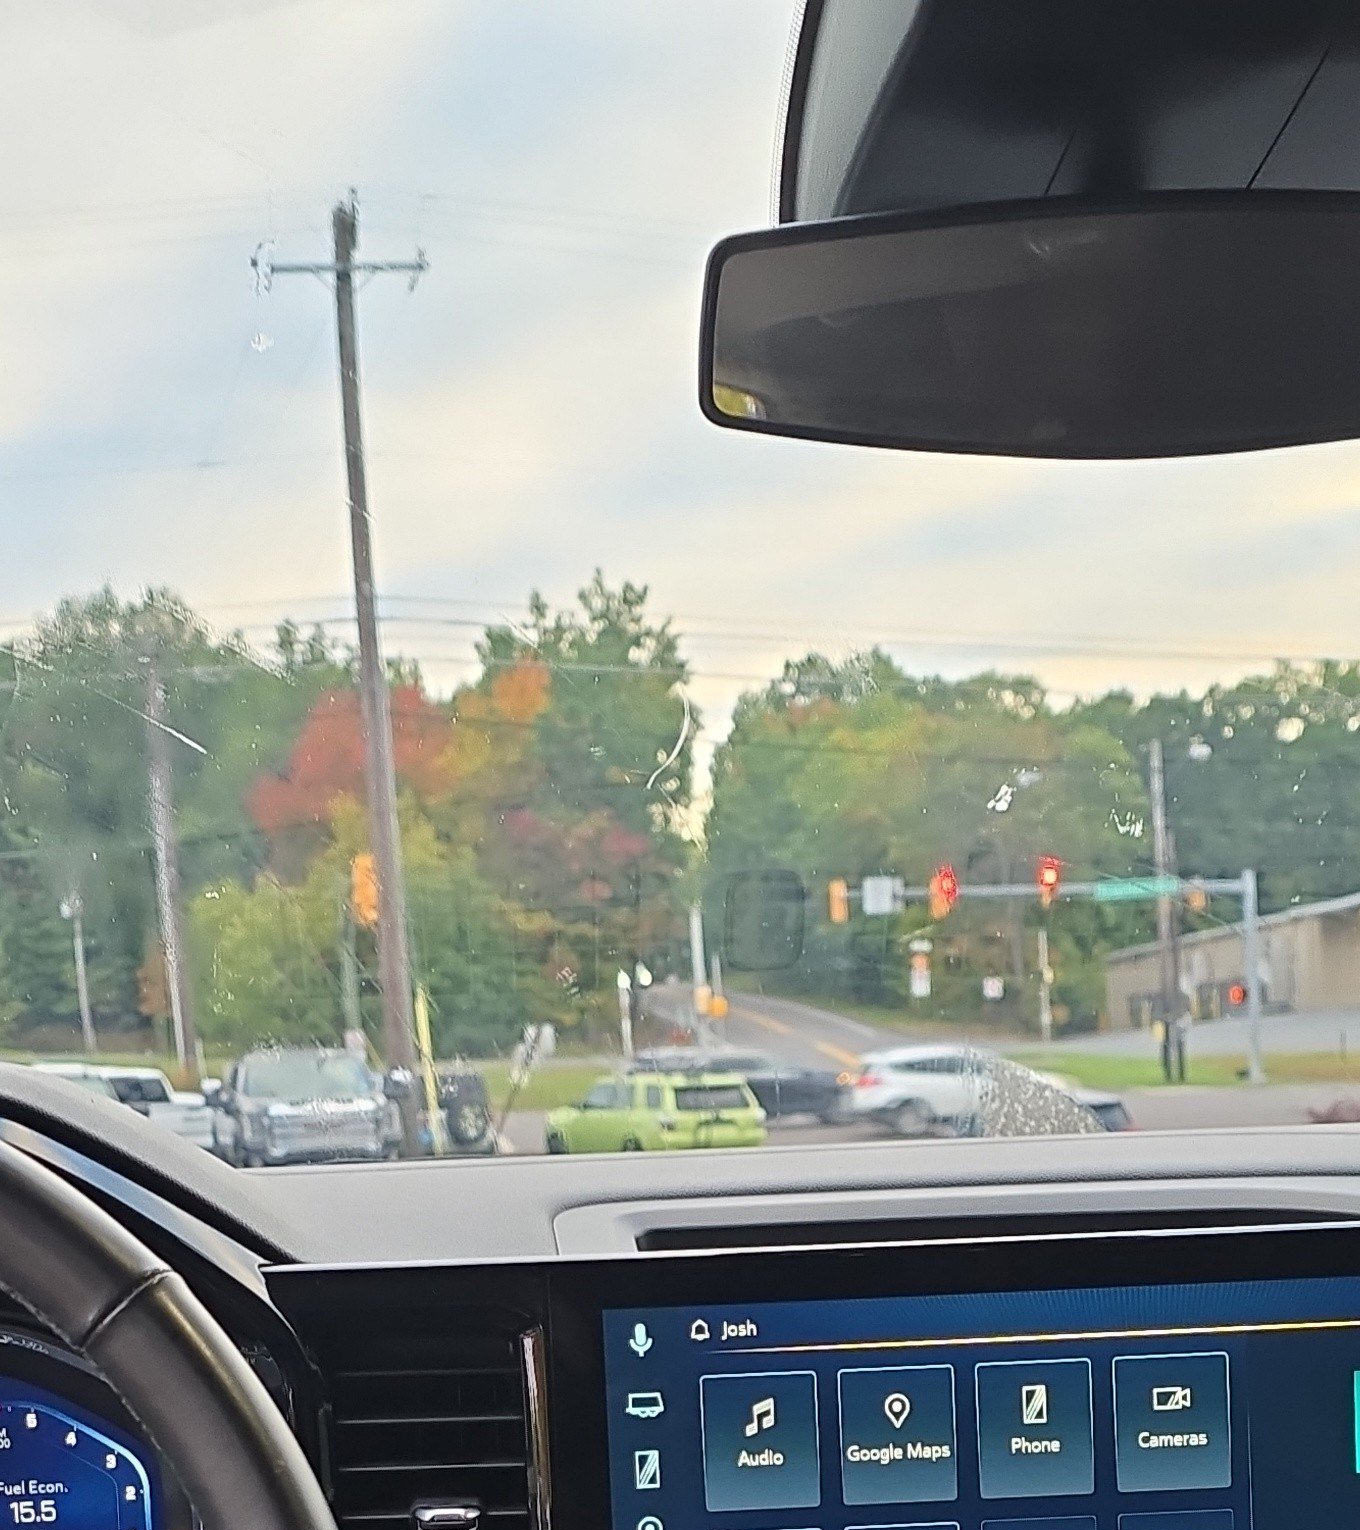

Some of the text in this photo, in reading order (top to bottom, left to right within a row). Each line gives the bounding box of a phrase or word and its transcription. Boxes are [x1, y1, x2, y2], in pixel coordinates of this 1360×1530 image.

[721, 1319, 757, 1341] Josh
[26, 1413, 37, 1428] 5
[66, 1431, 77, 1447] 4
[1011, 1436, 1061, 1454] Phone
[1138, 1431, 1208, 1449] Cameras
[106, 1453, 117, 1469] 3
[737, 1449, 784, 1467] Audio
[847, 1441, 951, 1465] Google Maps
[28, 1480, 69, 1494] Econ.
[125, 1485, 137, 1501] 2
[9, 1499, 57, 1524] 15.5
